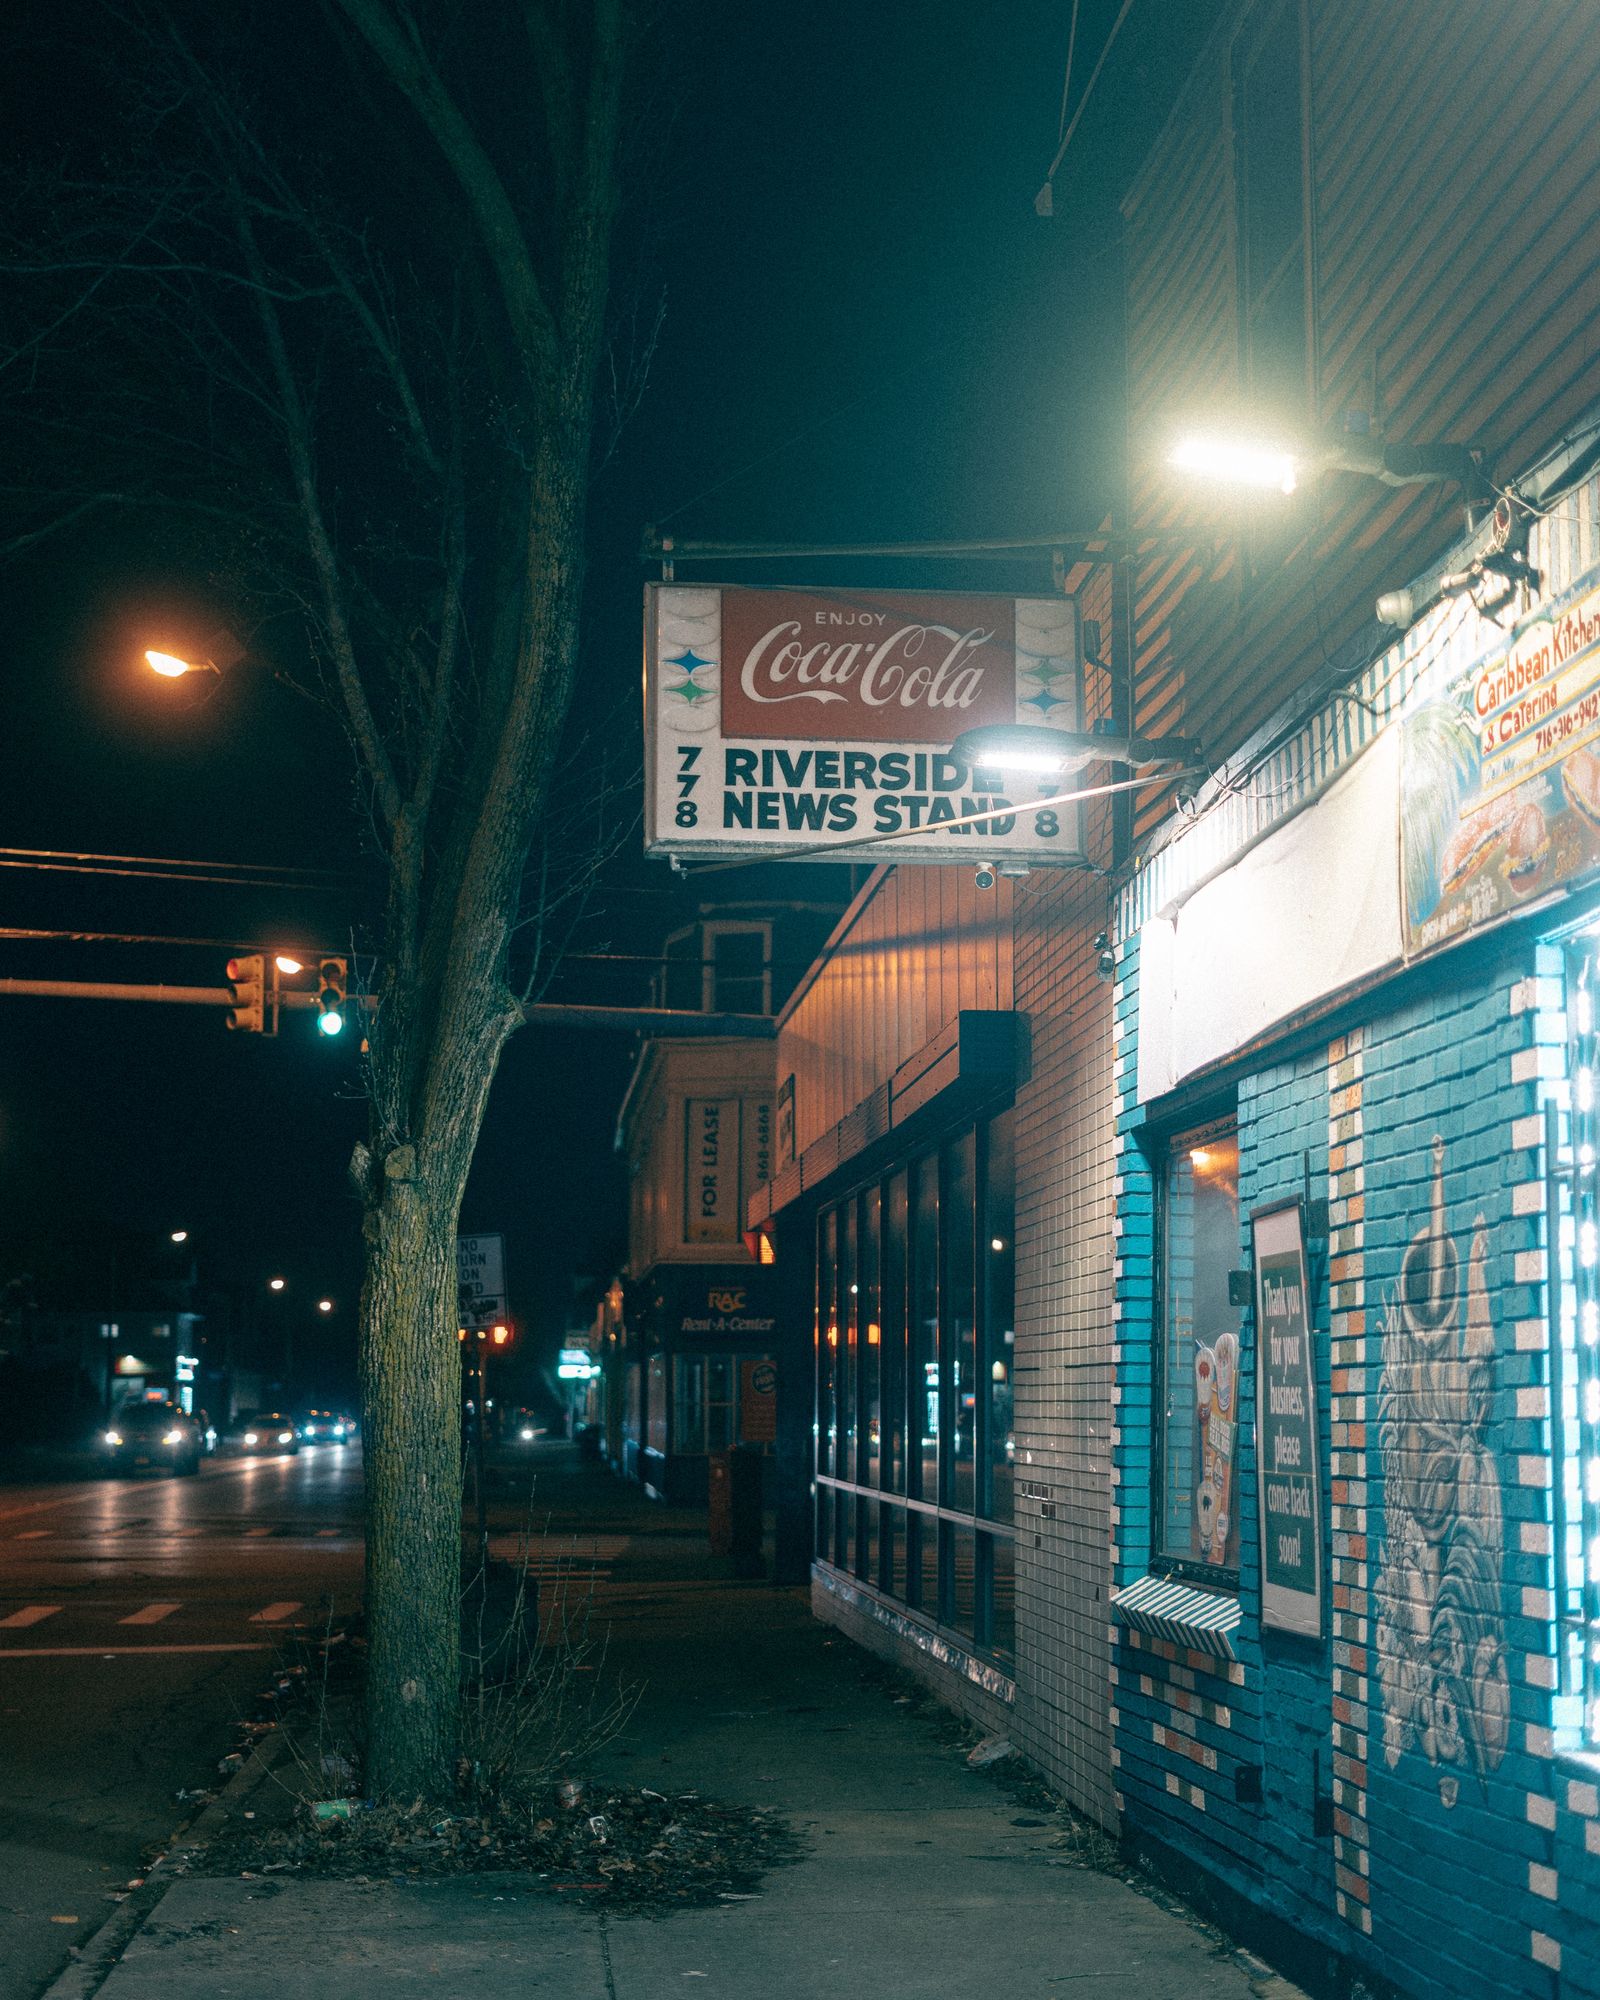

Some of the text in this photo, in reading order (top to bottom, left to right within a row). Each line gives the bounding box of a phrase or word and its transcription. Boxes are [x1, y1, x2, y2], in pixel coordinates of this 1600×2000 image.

[815, 611, 887, 627] ENJOY
[740, 620, 997, 709] Coca-Cola
[1474, 645, 1551, 717] Caribbean
[1499, 683, 1558, 743] Catering
[1536, 686, 1600, 754] 716-316-942
[724, 747, 1005, 794] RIVERSIDE
[722, 790, 1017, 837] NEWS STAND
[702, 1106, 720, 1217] FOR LEASE
[459, 1252, 487, 1267] URN
[461, 1239, 478, 1252] NO
[462, 1267, 480, 1281] ON
[708, 1291, 748, 1313] RAC
[1263, 1276, 1301, 1326] Thank you
[1270, 1326, 1300, 1385] for your
[1269, 1375, 1306, 1422] business,
[1274, 1425, 1301, 1474] please
[1267, 1475, 1311, 1518] come back
[1278, 1528, 1302, 1568] soon!
